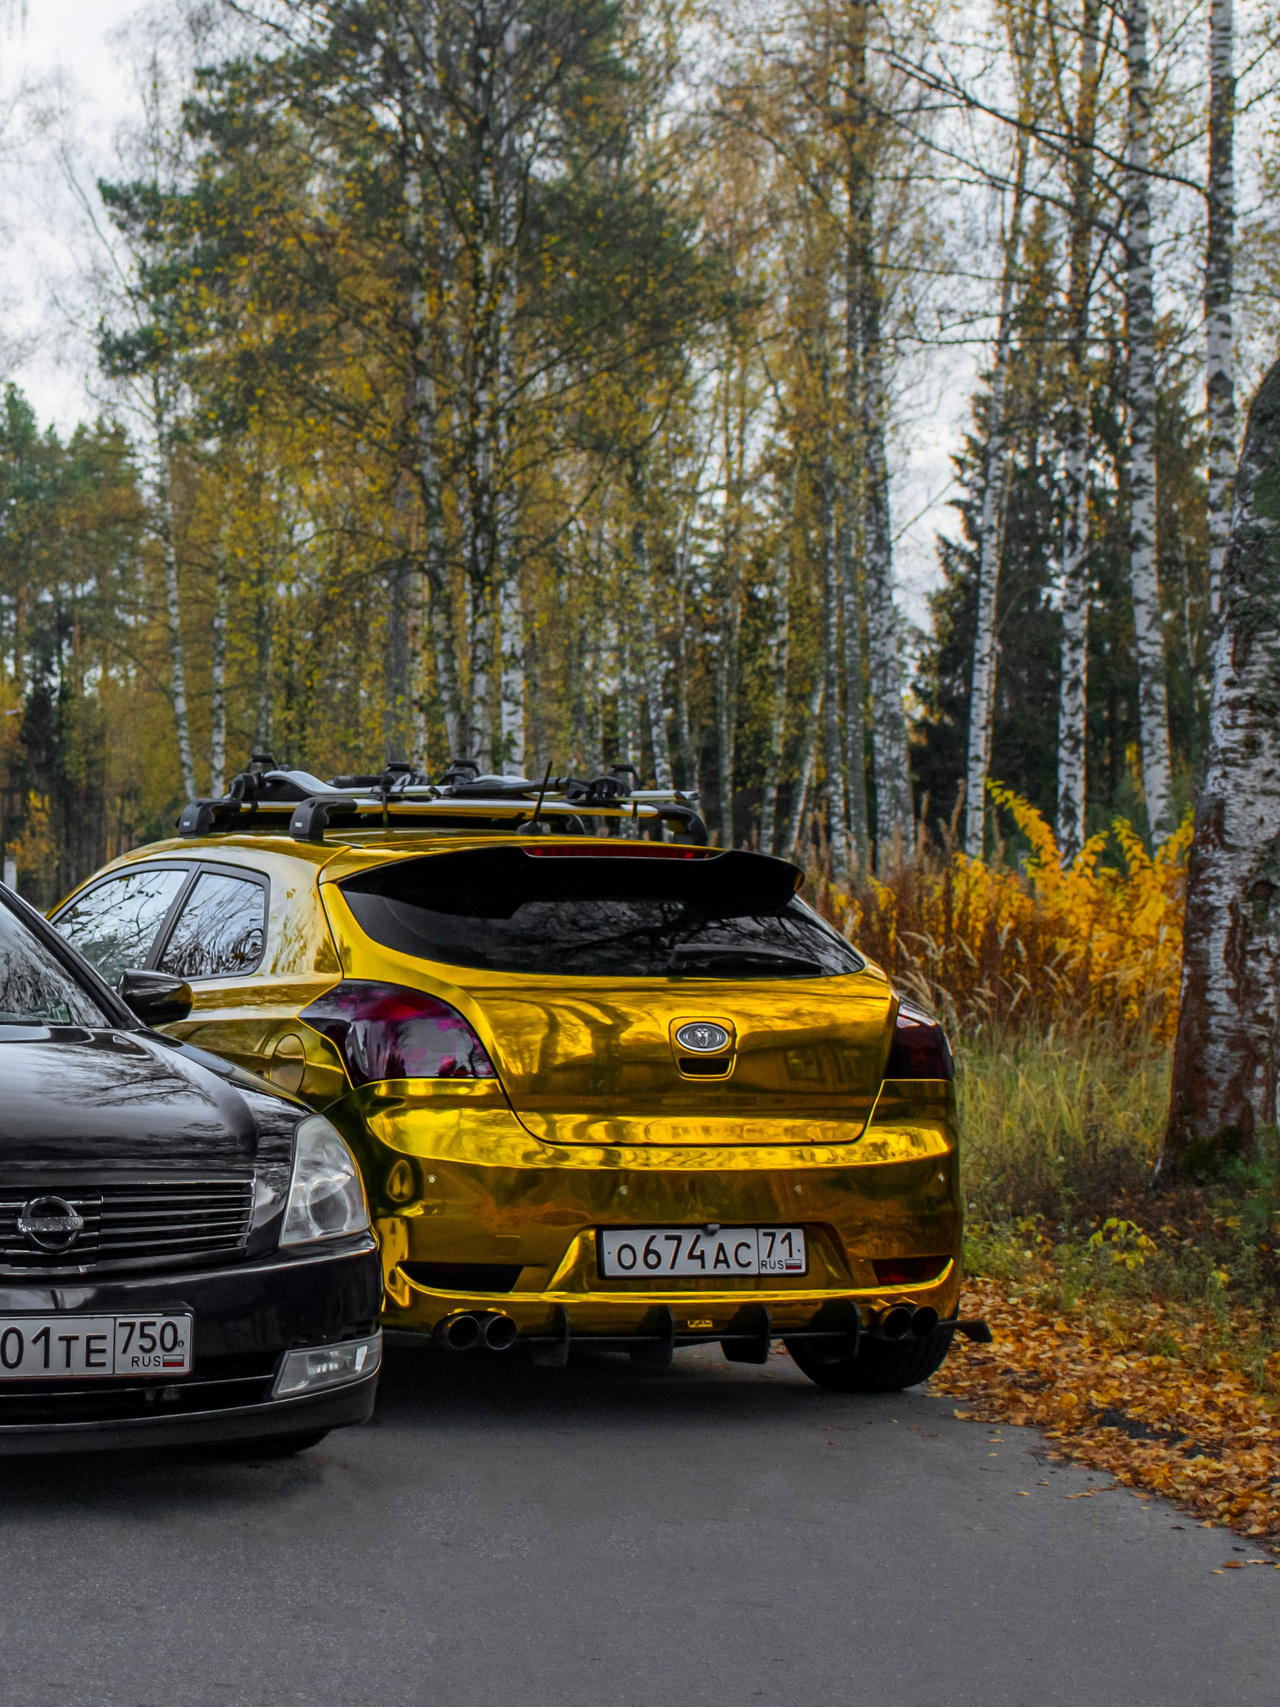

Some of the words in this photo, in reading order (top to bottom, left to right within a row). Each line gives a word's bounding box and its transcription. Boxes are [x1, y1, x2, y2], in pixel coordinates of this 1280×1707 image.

[616, 1234, 753, 1270] O674AC
[761, 1231, 794, 1259] 71
[760, 1259, 785, 1270] RUS
[118, 1320, 179, 1354] 750
[131, 1354, 162, 1368] RUS
